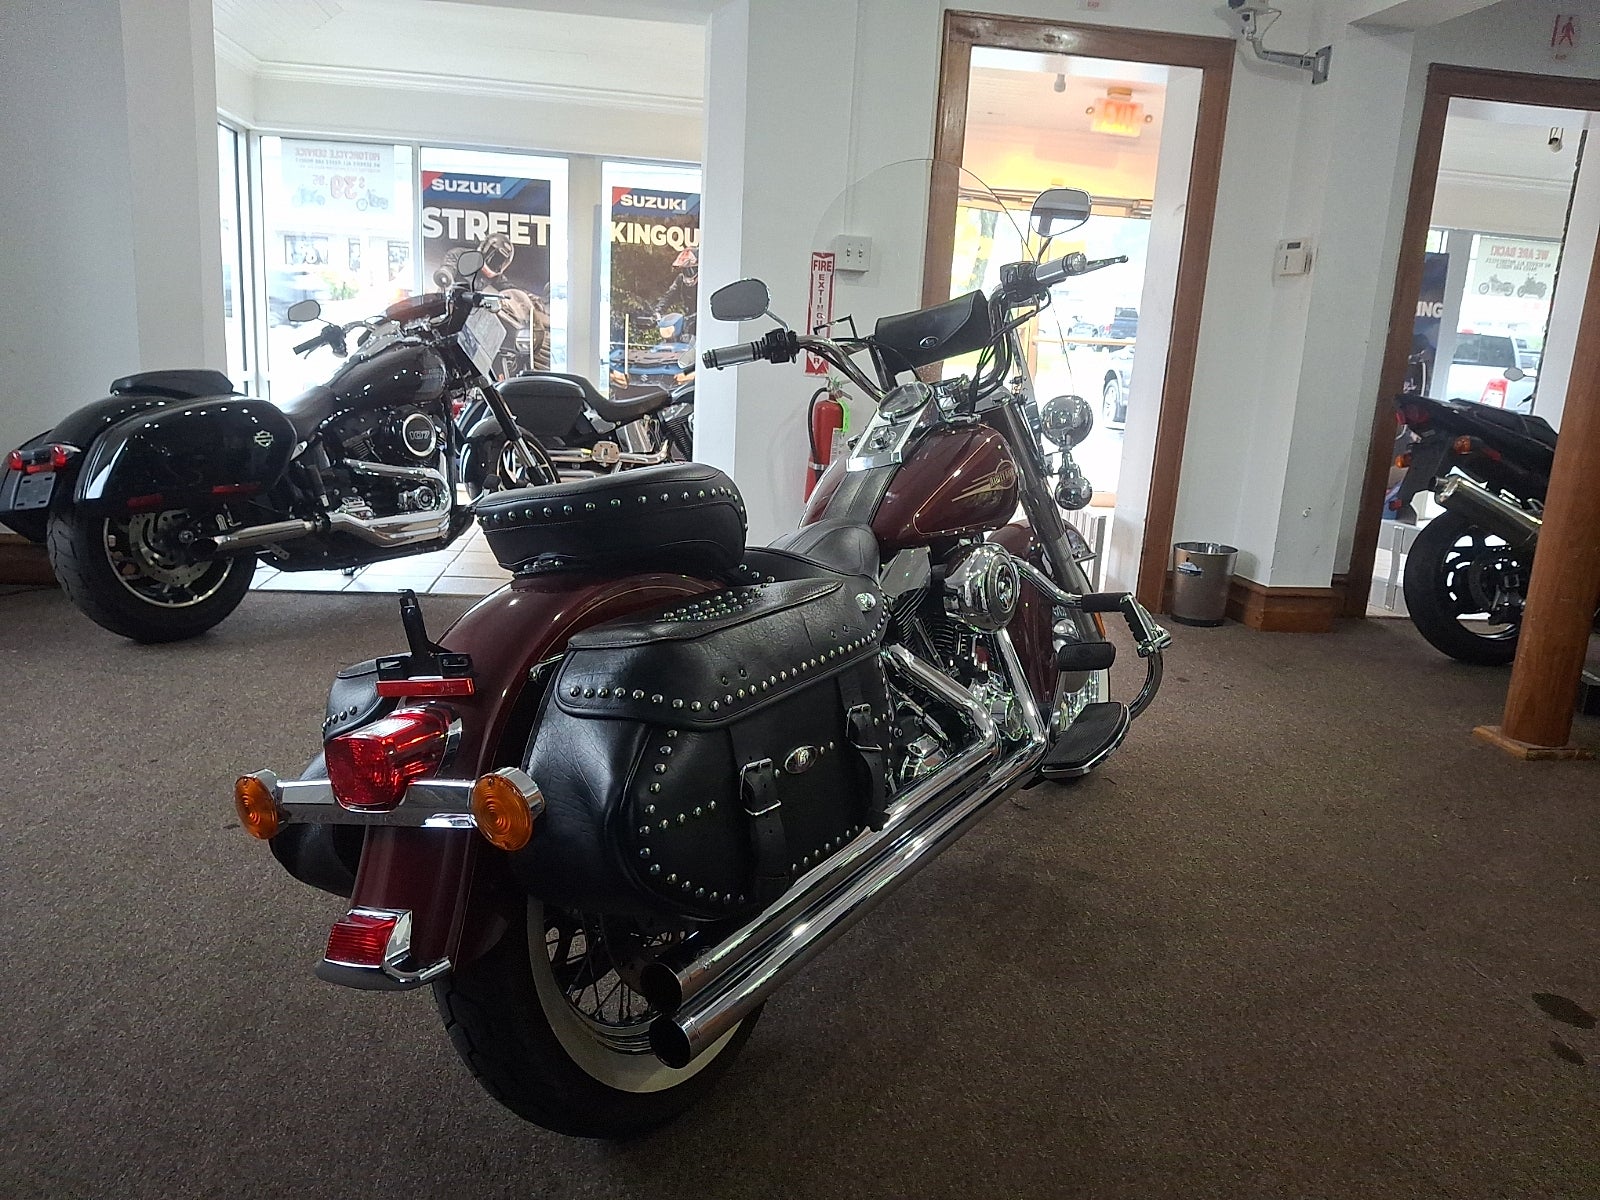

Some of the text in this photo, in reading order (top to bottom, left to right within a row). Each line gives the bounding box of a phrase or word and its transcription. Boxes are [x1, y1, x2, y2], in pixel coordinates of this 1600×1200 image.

[431, 178, 501, 195] SUZUKI
[620, 194, 687, 211] SUZUKI
[422, 206, 550, 246] STREET
[610, 221, 701, 252] KINGQU
[813, 260, 832, 272] FIRE
[409, 430, 430, 440] 107
